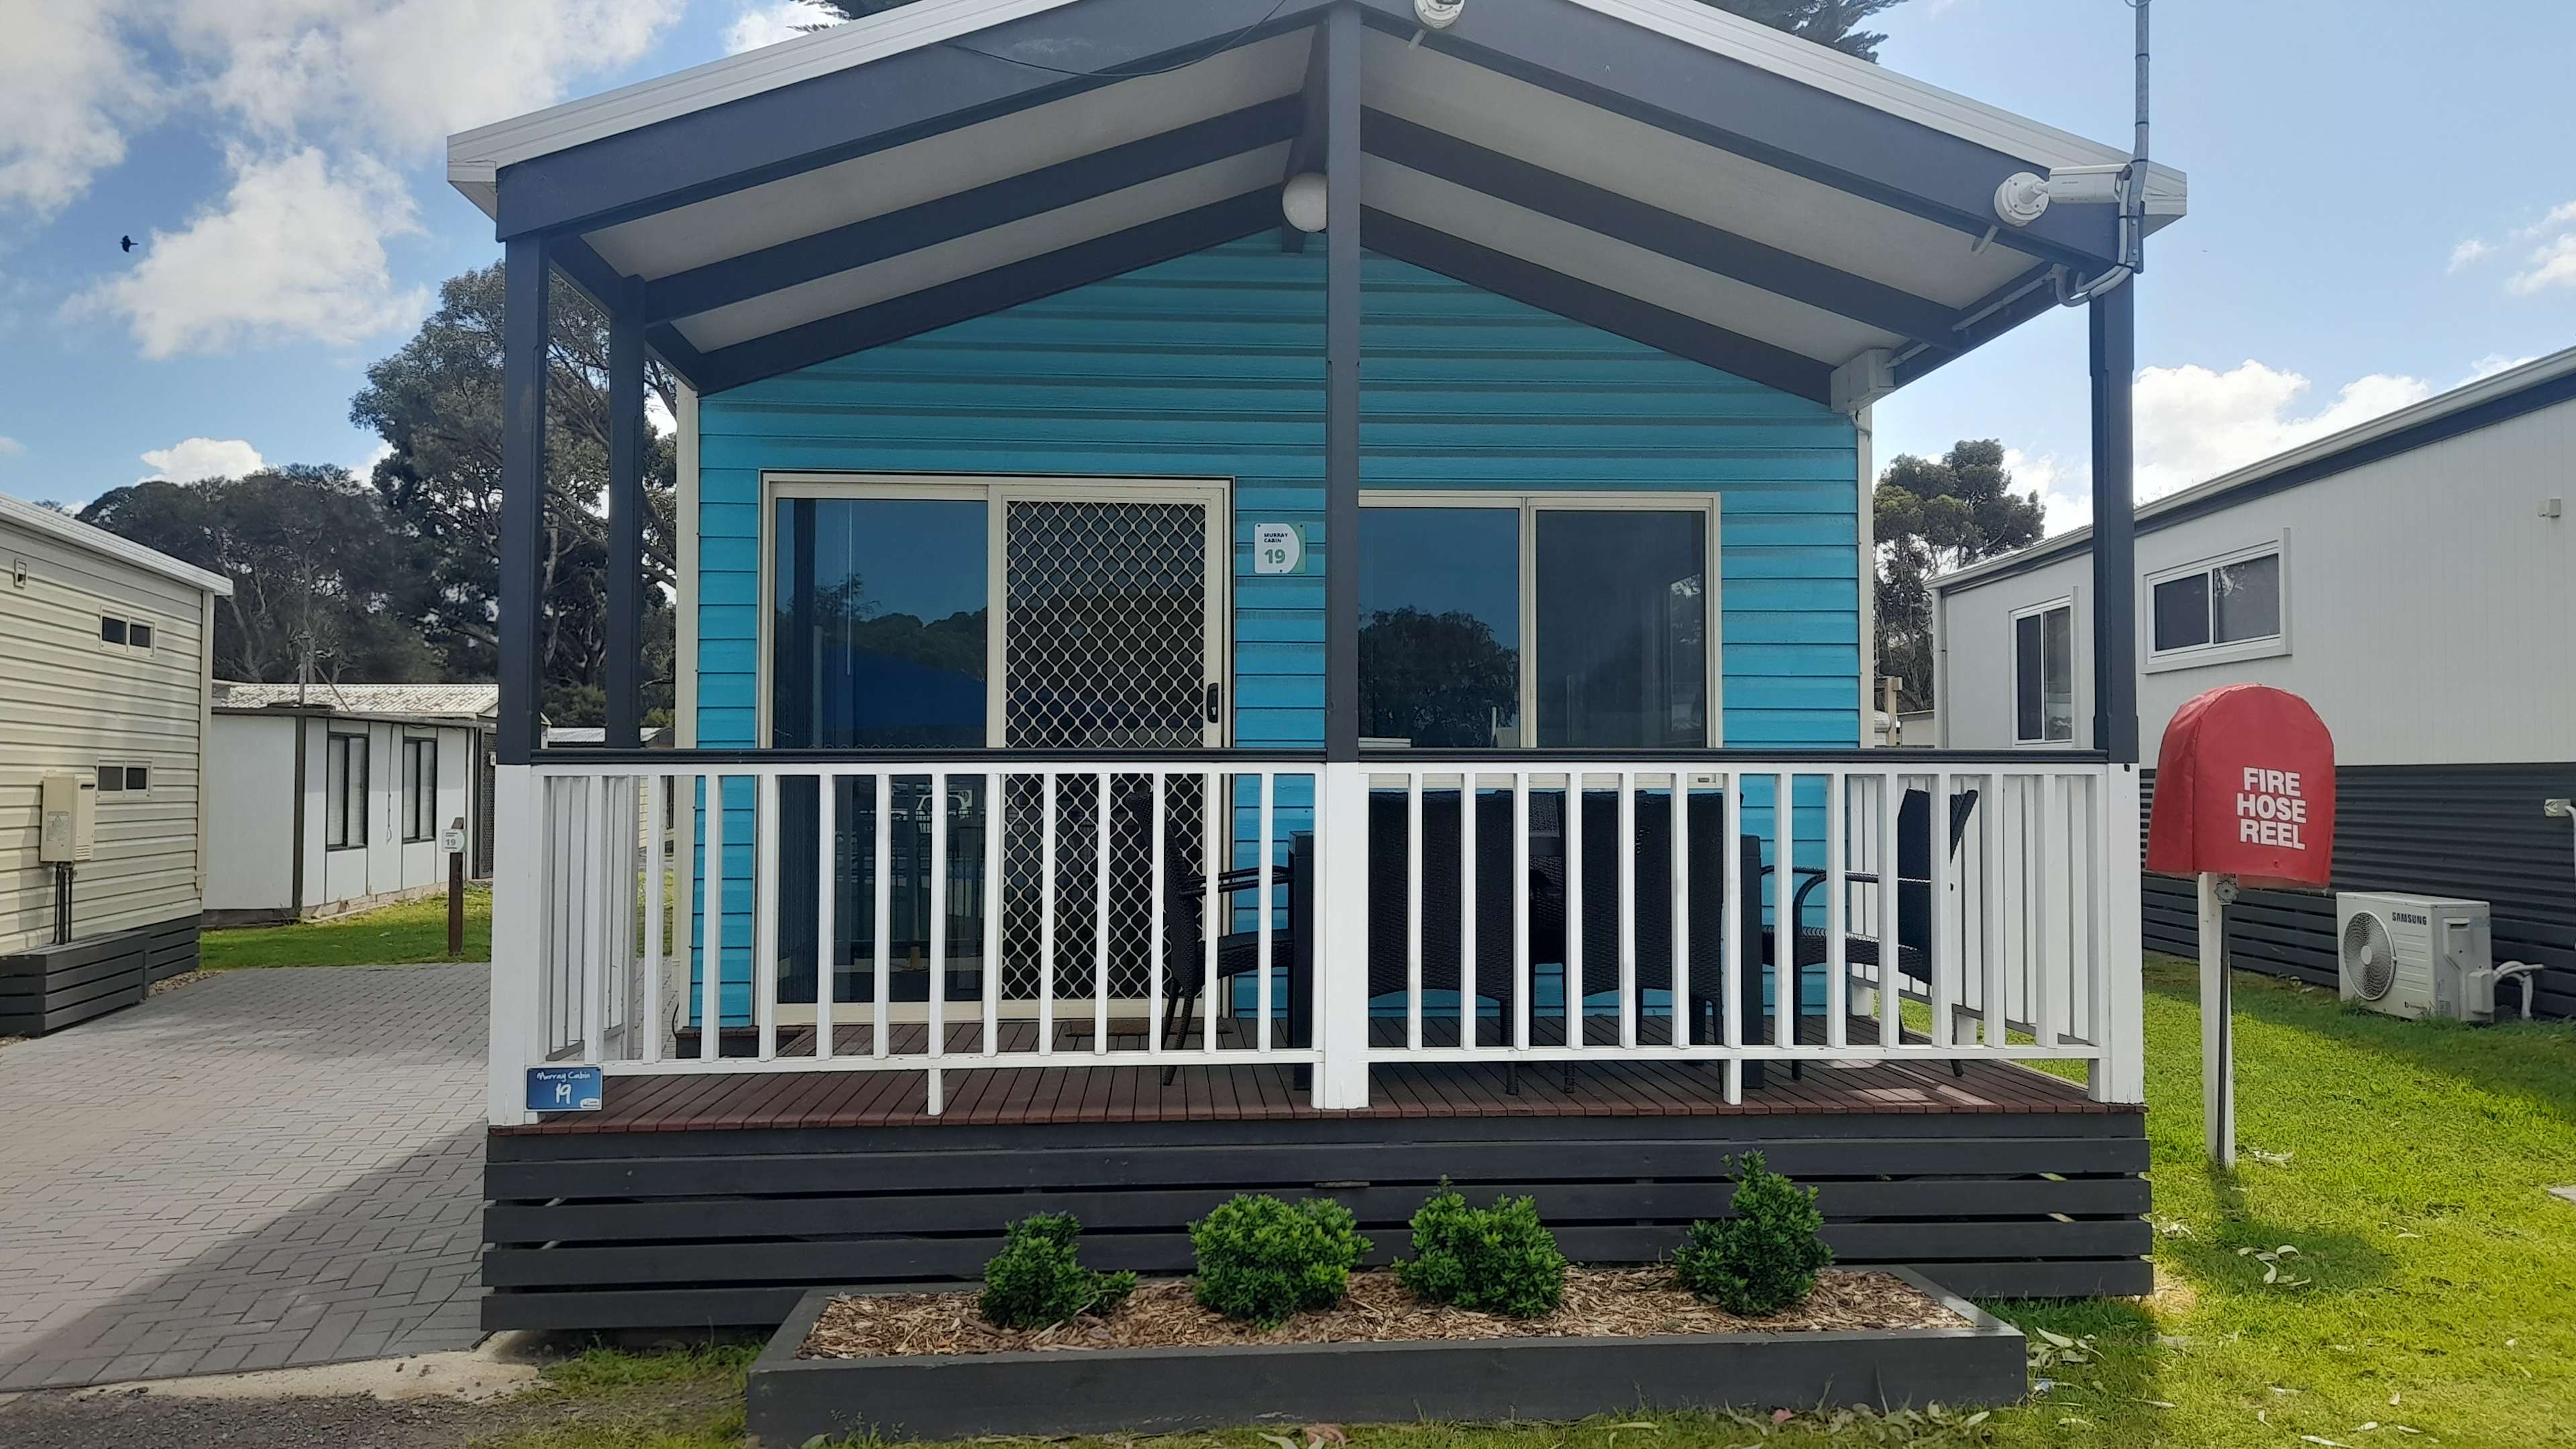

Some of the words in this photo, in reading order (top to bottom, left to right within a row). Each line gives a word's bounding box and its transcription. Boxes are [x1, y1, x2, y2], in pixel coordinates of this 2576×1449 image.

[1265, 549, 1285, 564] 19
[2243, 767, 2301, 796] FIRE
[2237, 792, 2306, 823] HOSE
[2240, 818, 2306, 850] REEL
[2392, 912, 2427, 925] SAMSUNG
[537, 1071, 567, 1082] Murray
[568, 1071, 590, 1079] Cabin
[555, 1083, 572, 1104] 19
